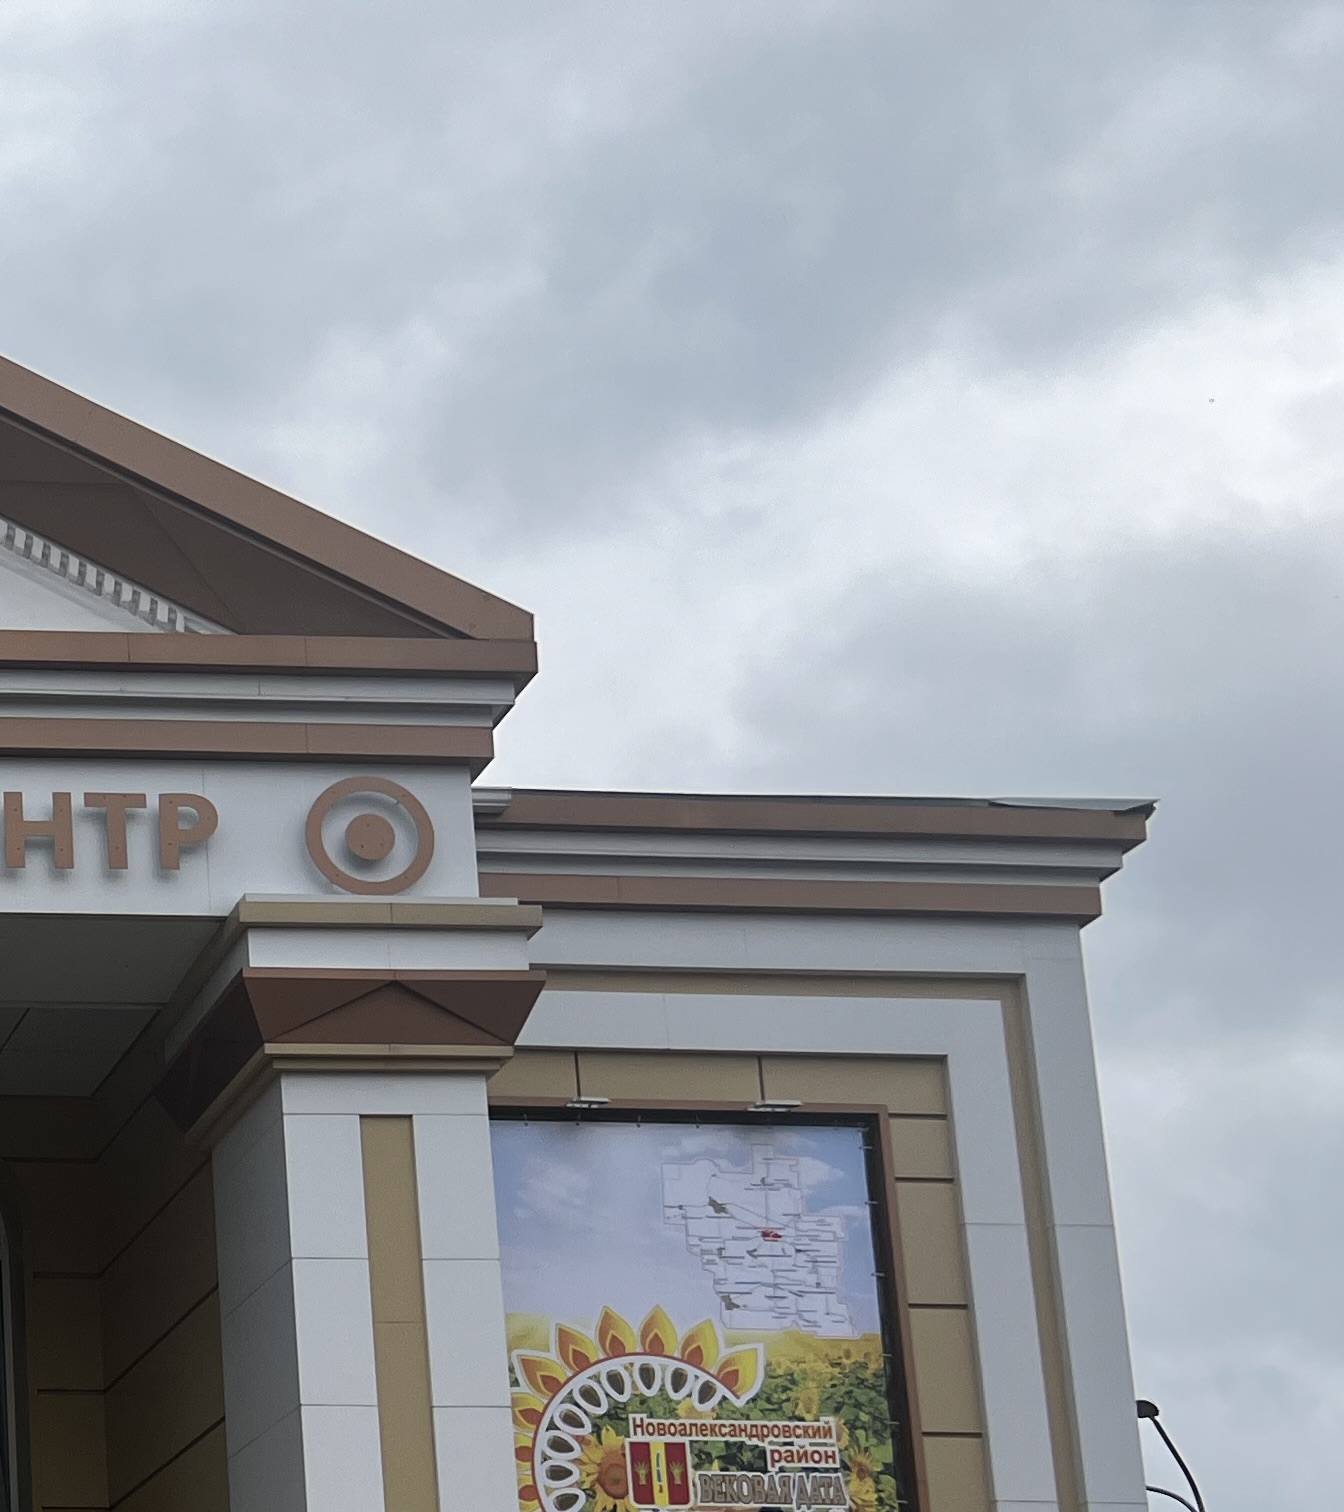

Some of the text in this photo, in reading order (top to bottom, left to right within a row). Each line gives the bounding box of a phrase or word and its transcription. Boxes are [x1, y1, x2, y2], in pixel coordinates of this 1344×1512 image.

[632, 1416, 833, 1441] Новоалександровский
[770, 1445, 837, 1468] район
[698, 1473, 847, 1509] ВЕКОВАЯ ДАТА
